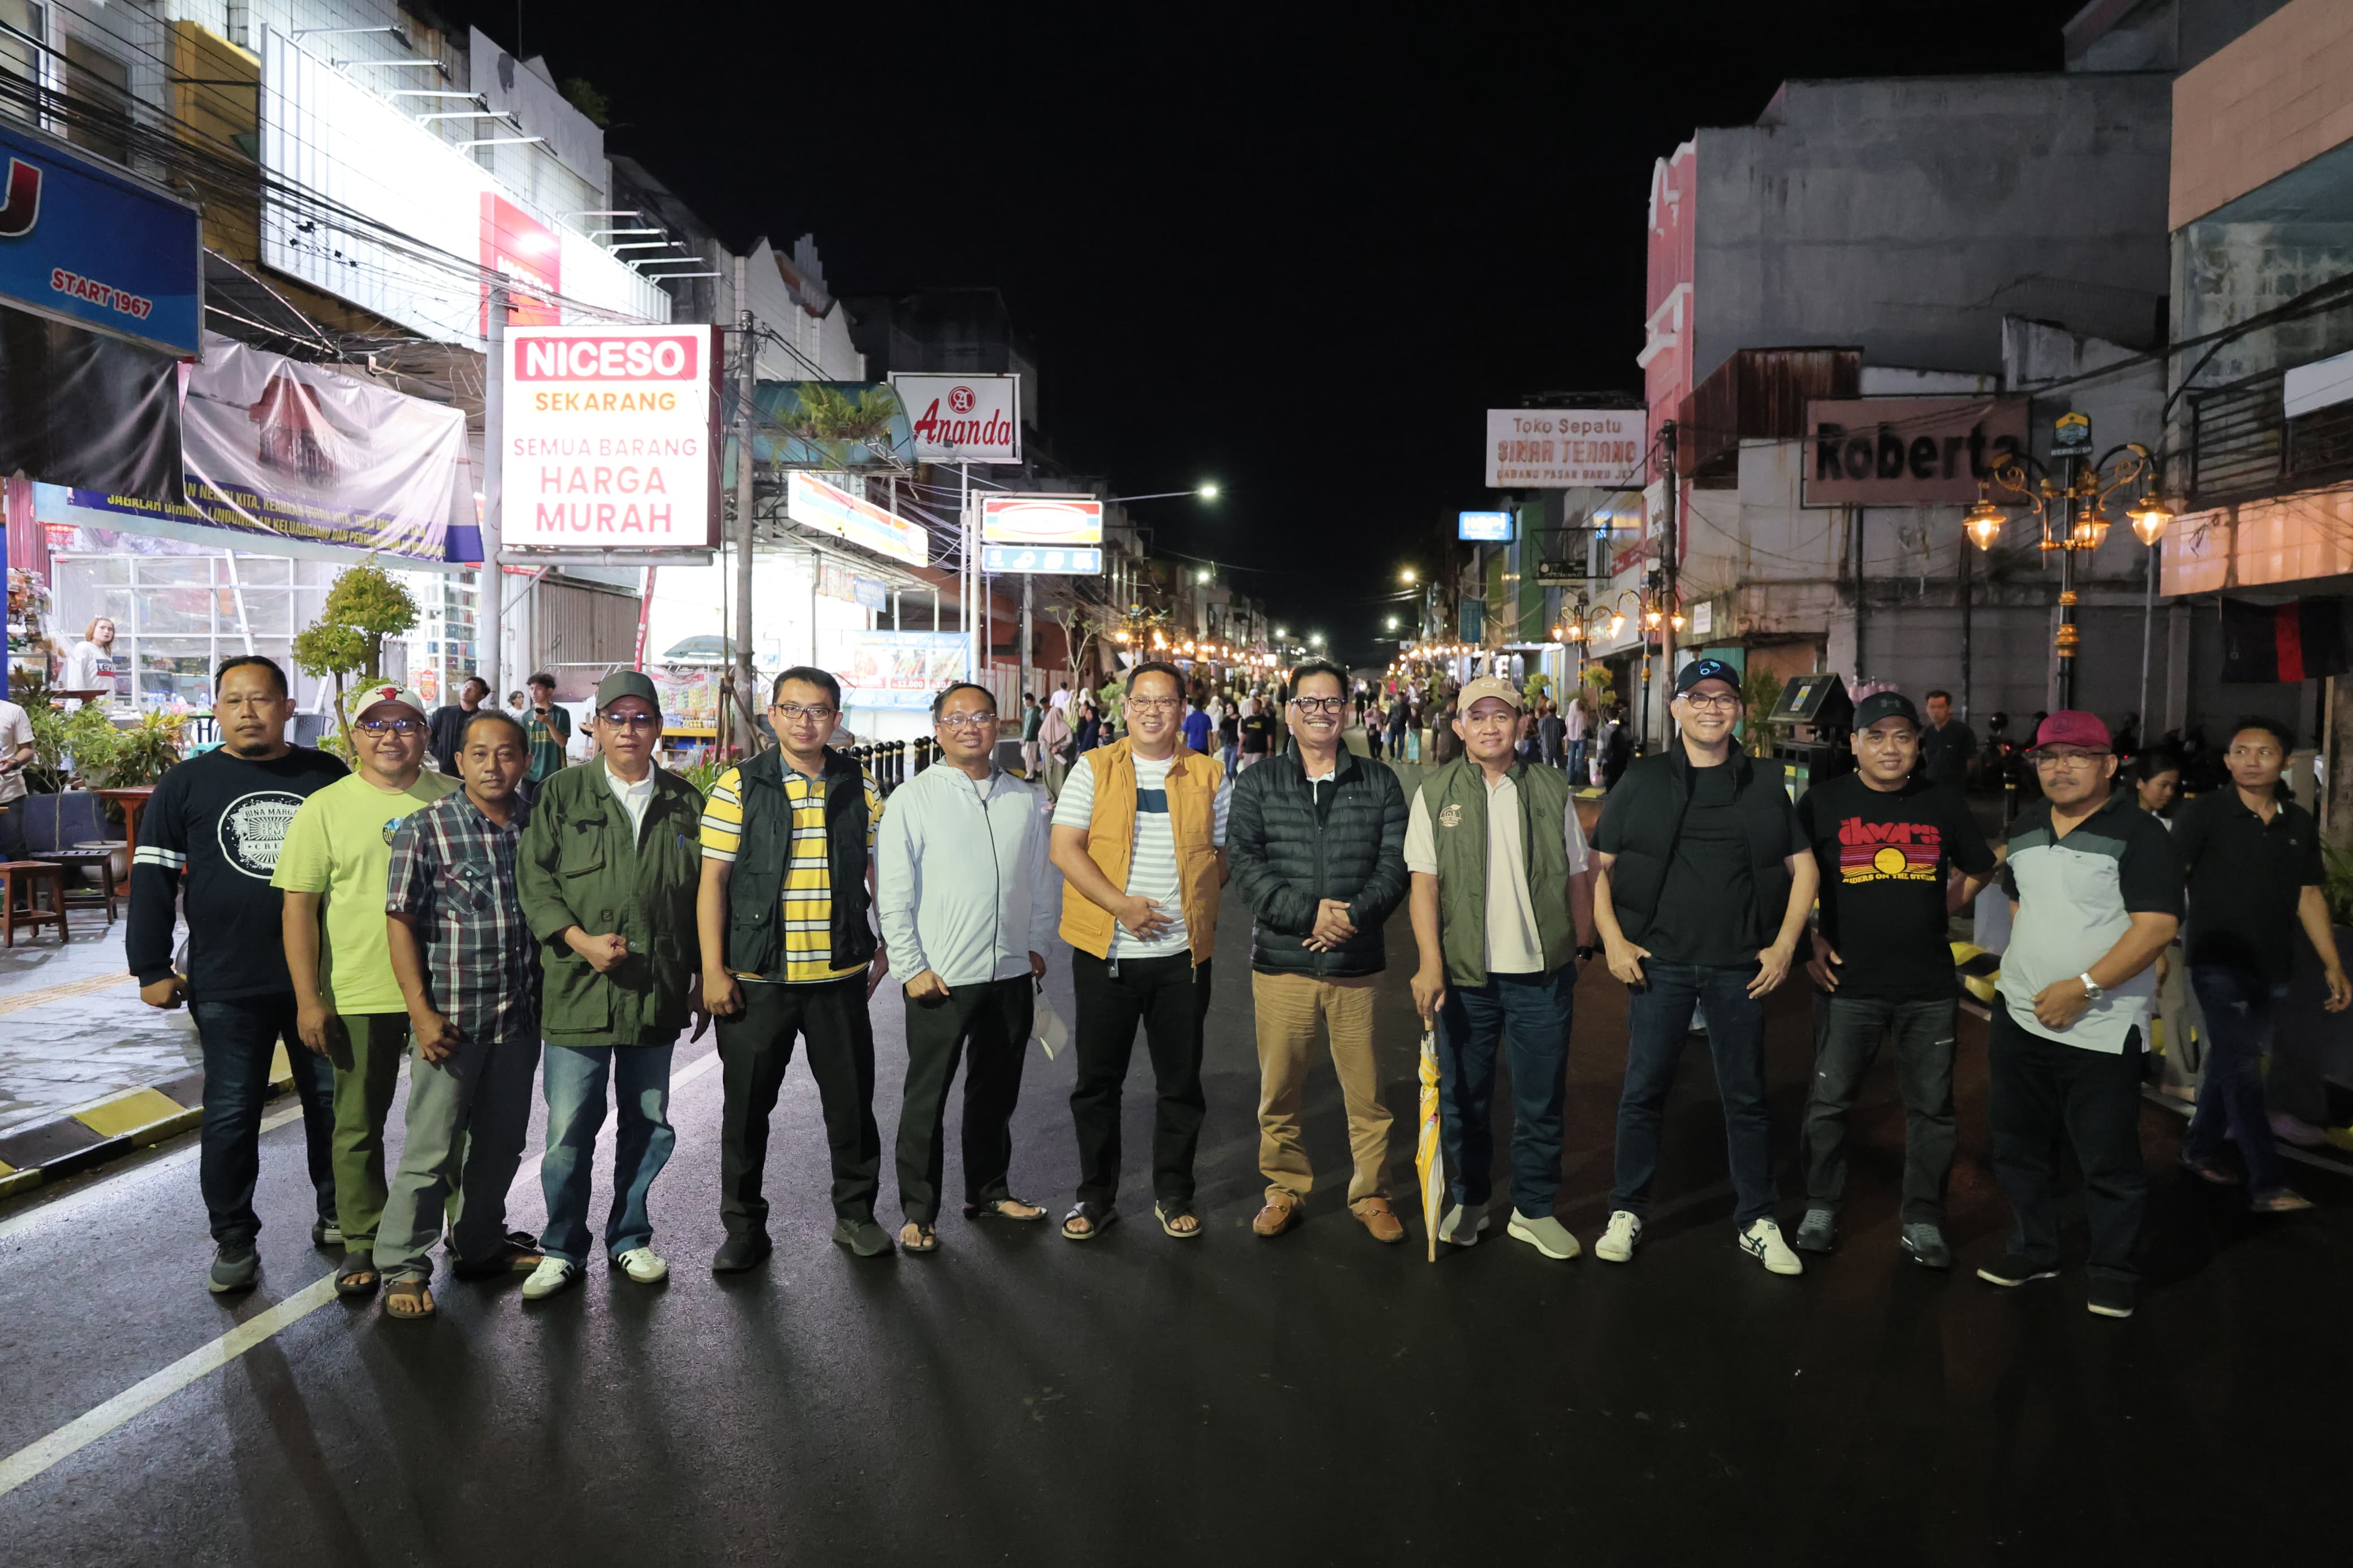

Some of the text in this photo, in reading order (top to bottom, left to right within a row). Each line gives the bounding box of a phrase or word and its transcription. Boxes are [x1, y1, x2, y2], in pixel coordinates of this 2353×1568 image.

[51, 269, 152, 319] START 1967
[527, 340, 685, 377] NICESO
[535, 392, 676, 411] SEKARANG
[913, 398, 1011, 446] Ananda
[1513, 418, 1621, 437] Toko Sepatu
[514, 438, 697, 456] SEMUA BARANG
[1817, 422, 2019, 481] Roberta
[541, 466, 667, 495] HARGA
[536, 503, 671, 533] MURAH
[898, 680, 924, 689] 12.000
[245, 809, 266, 818] BINA
